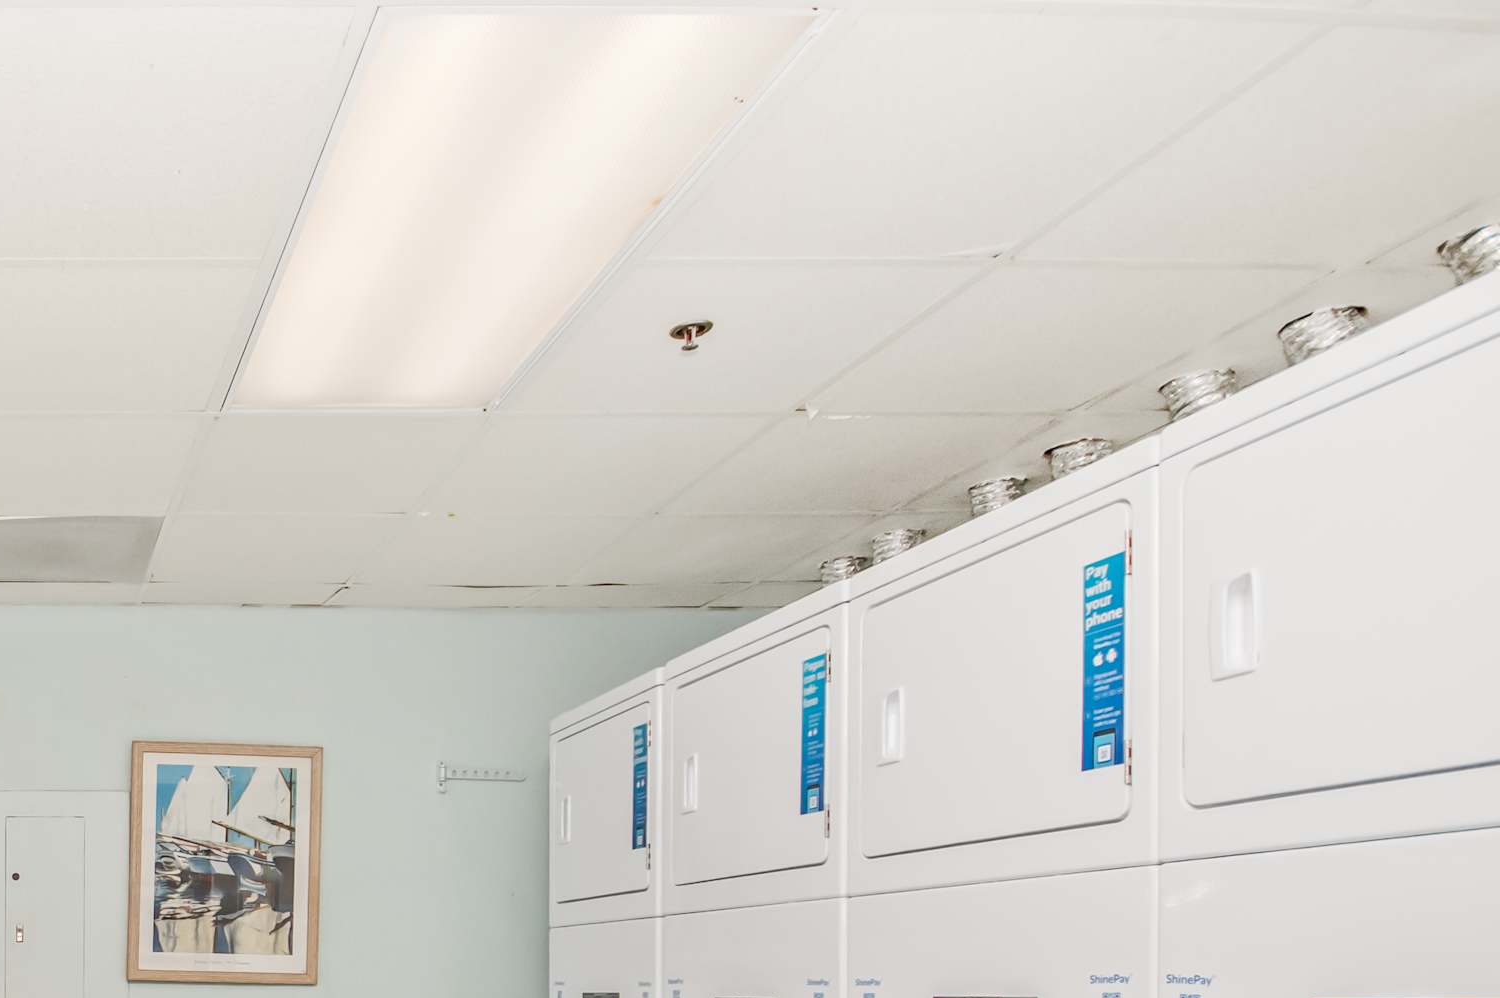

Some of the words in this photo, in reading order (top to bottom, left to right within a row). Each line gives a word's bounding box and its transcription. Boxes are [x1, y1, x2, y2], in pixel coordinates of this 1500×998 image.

[1086, 563, 1109, 581] Pay
[1086, 578, 1112, 597] with
[1086, 594, 1113, 616] your
[1086, 607, 1124, 631] phone
[1090, 974, 1130, 985] ShinePay
[1166, 974, 1213, 988] ShinePay
